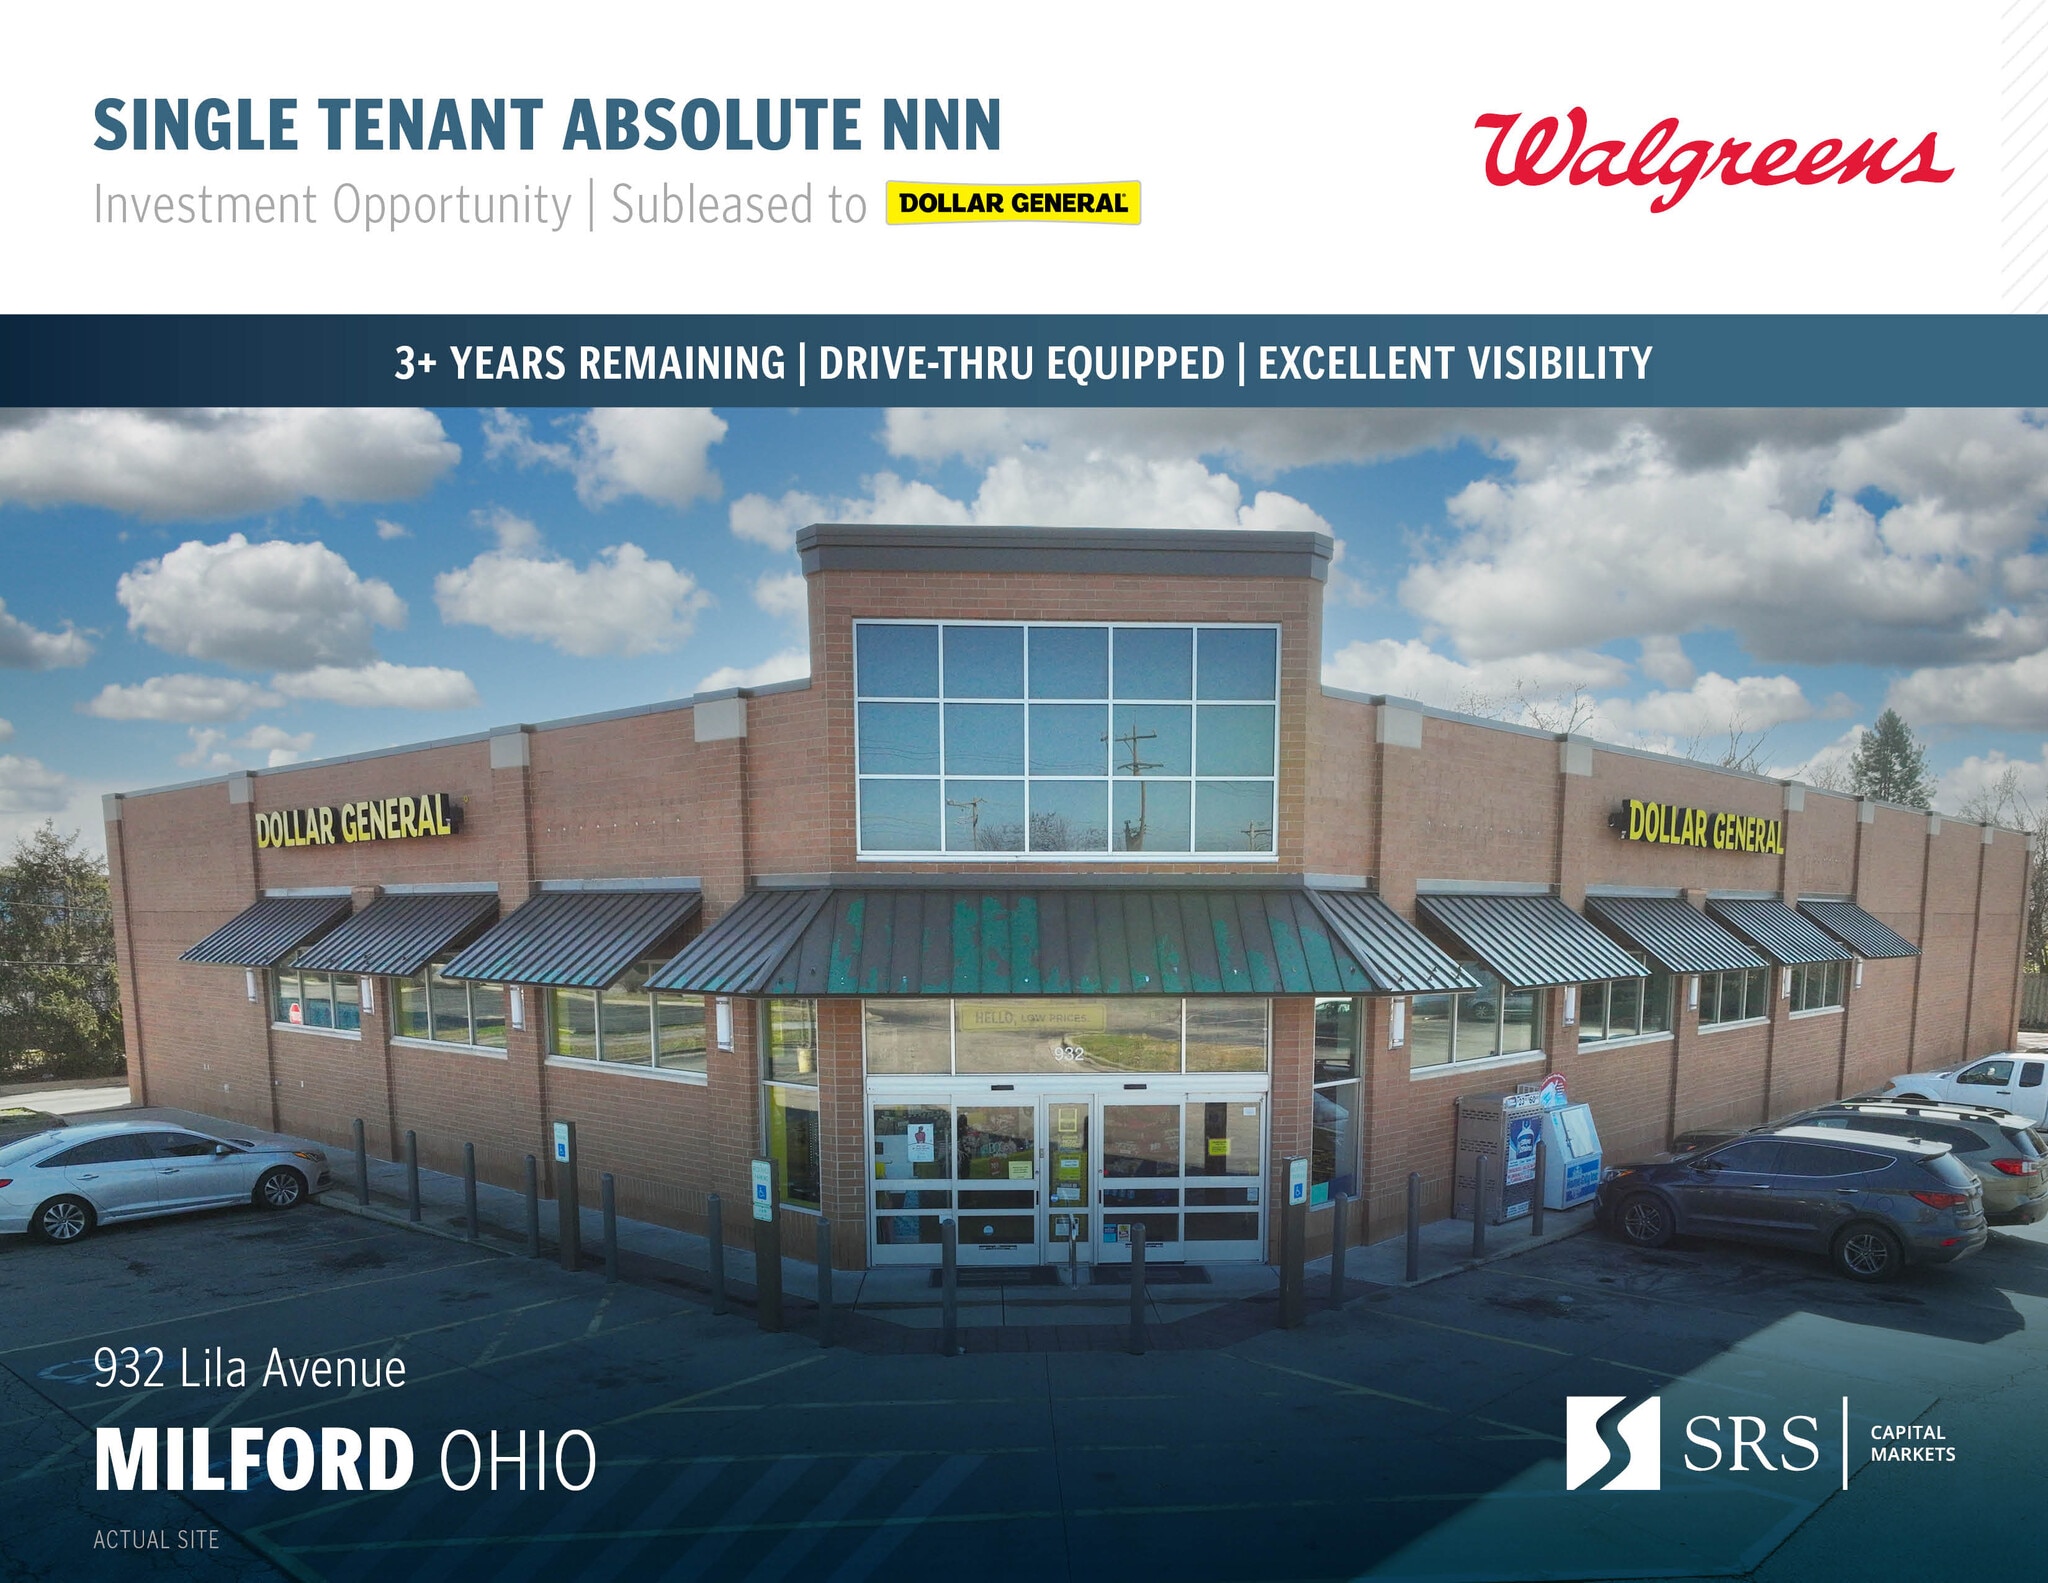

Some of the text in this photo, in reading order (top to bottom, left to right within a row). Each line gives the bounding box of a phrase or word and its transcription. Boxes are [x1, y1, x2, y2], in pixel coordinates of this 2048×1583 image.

[255, 792, 451, 849] DOLLAR GENERAL
[1629, 799, 1785, 855] DOLLAR GENERAL
[1021, 1014, 1046, 1023] LOW
[1054, 1047, 1085, 1061] 932
